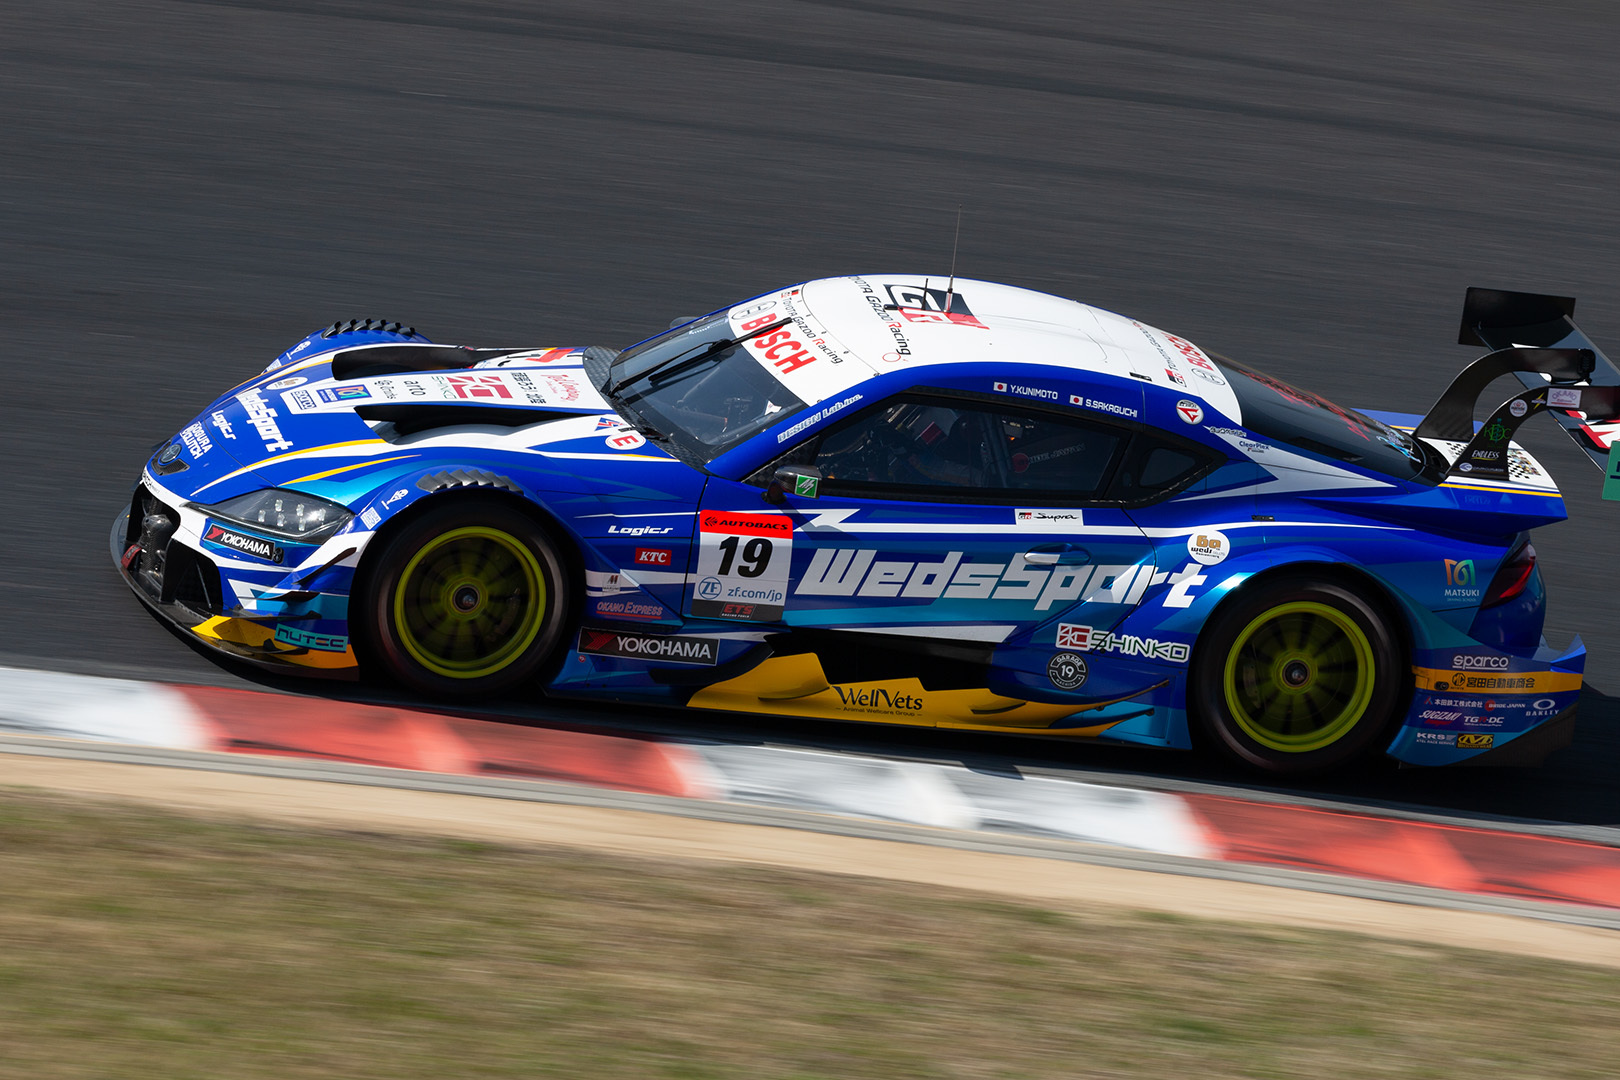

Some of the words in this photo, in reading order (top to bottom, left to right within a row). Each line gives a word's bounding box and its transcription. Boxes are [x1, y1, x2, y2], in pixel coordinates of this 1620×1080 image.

[792, 316, 816, 338] GAZOO
[812, 338, 843, 364] Racing
[885, 321, 911, 355] Racing
[404, 380, 426, 396] arto
[1010, 385, 1058, 400] Y.KUNIMOTO
[1085, 399, 1138, 418] S.SAKAGUCHI
[211, 410, 237, 440] Logics
[777, 412, 821, 443] DESIGN
[612, 435, 639, 447] E
[1471, 450, 1500, 459] ENDLESS
[1034, 512, 1080, 523] Supra
[608, 525, 673, 536] Logics
[719, 520, 788, 531] AUTOBACS
[220, 531, 271, 557] YOKOHAMA
[639, 551, 668, 563] KTC
[717, 536, 773, 578] 19
[794, 548, 1208, 611] WedsSport
[727, 586, 783, 602] zf.com/jp
[1444, 589, 1480, 597] MATSUKI
[596, 602, 624, 612] OKANO
[723, 604, 754, 614] ETS
[617, 637, 711, 659] YOKOHAMA
[1090, 631, 1189, 661] SHINKO
[1056, 654, 1082, 667] GARAGE
[1453, 655, 1509, 670] sparco
[1061, 665, 1075, 678] 19
[1418, 709, 1463, 721] SUGIZAKI
[1416, 732, 1446, 741] KRS
